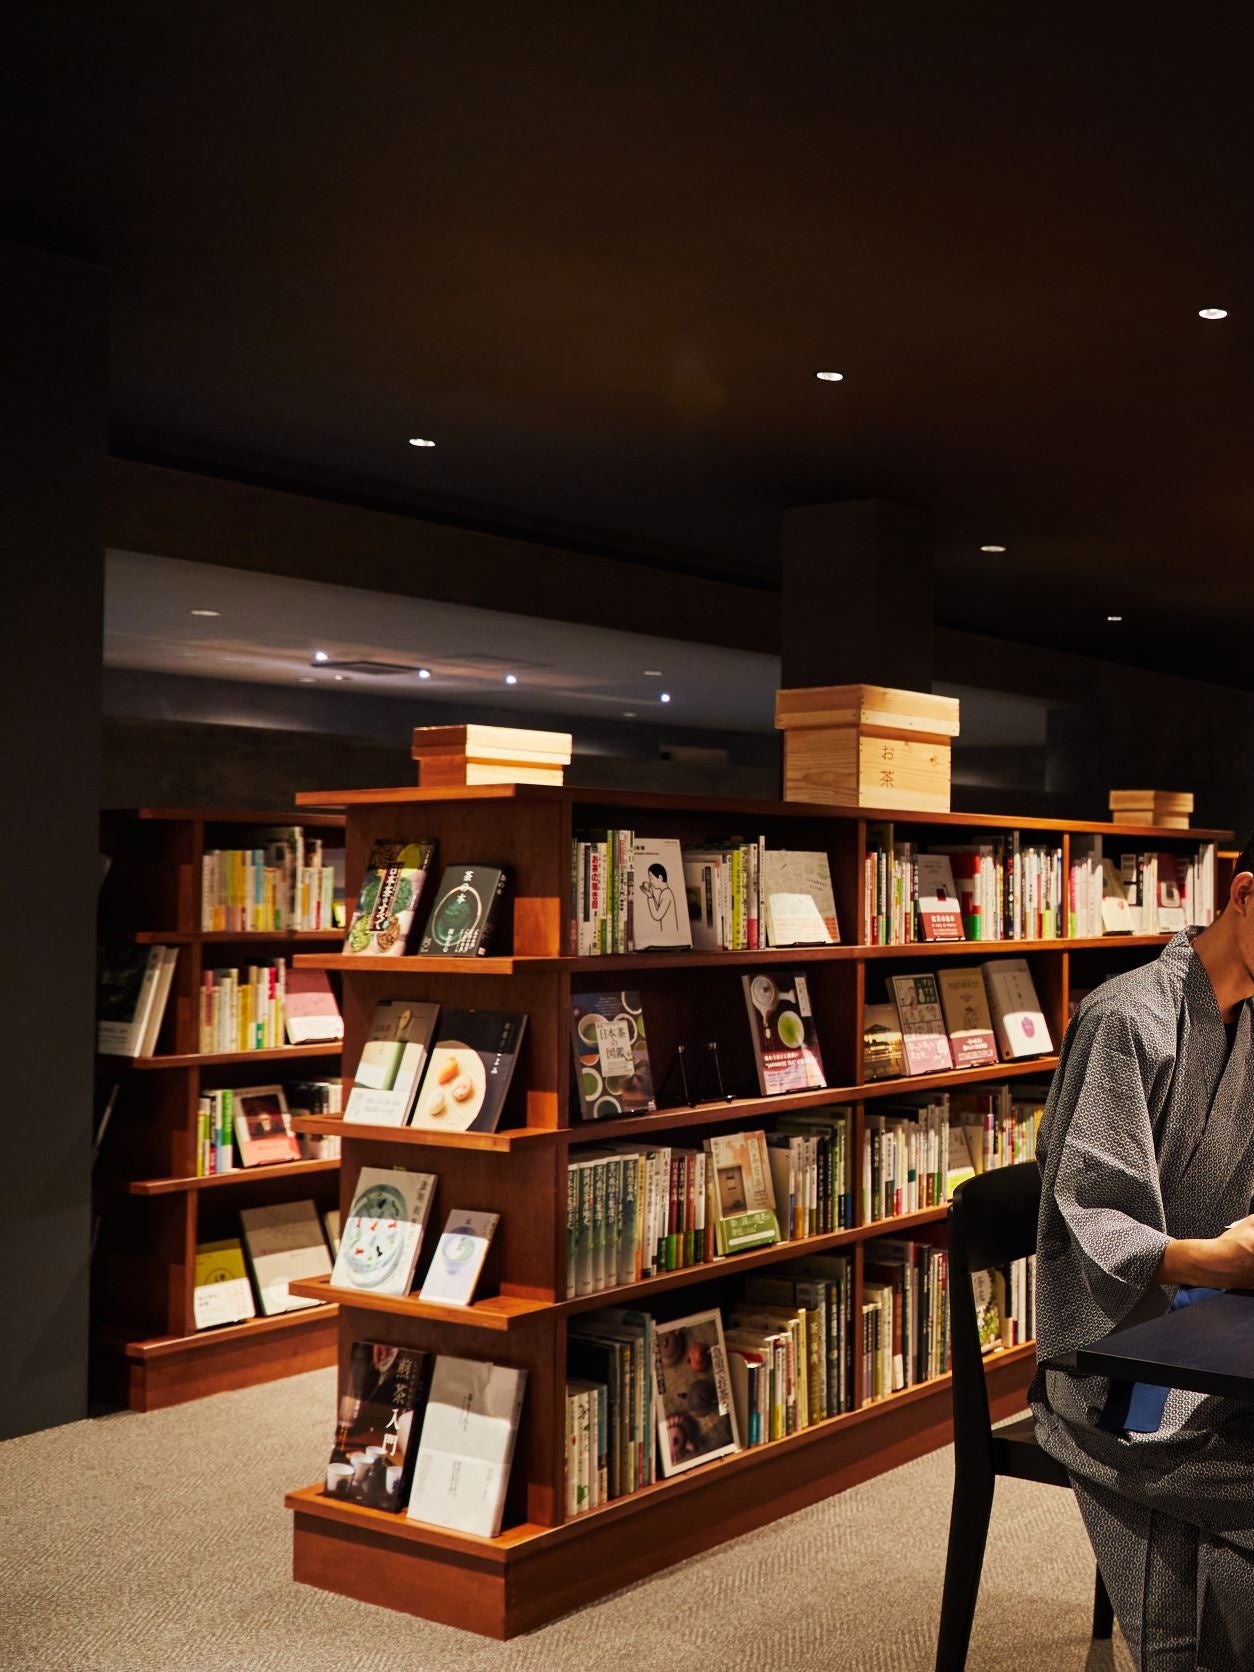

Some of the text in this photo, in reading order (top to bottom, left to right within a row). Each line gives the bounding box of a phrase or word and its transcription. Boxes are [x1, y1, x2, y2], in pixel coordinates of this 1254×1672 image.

[879, 744, 895, 789] お茶
[456, 869, 475, 905] 茶の本
[600, 1026, 627, 1041] 日本茶
[382, 1358, 413, 1457] 煎茶入門
